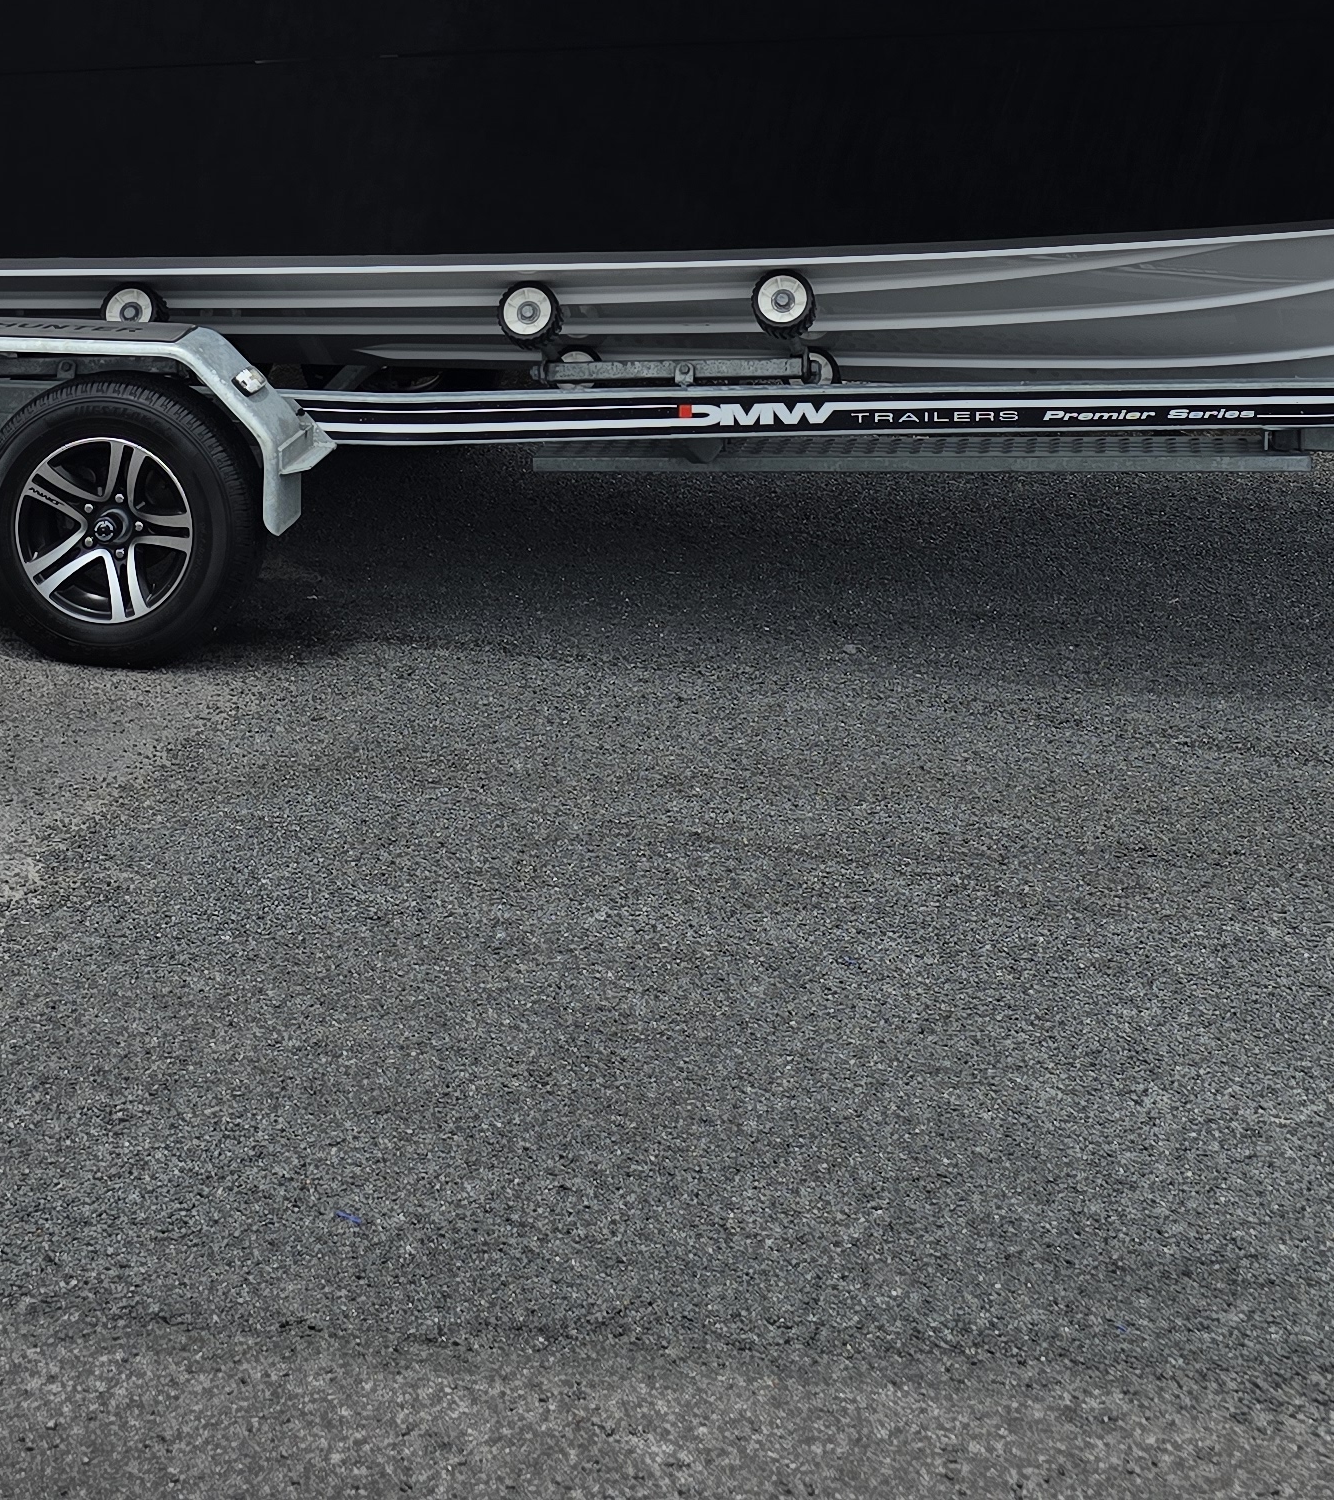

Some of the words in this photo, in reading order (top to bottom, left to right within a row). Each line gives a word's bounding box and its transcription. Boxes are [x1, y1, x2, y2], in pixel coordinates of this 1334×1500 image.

[678, 402, 834, 426] DMW
[851, 411, 1019, 423] TRAILERS
[1043, 410, 1155, 421] Premier
[1167, 409, 1255, 420] Series
